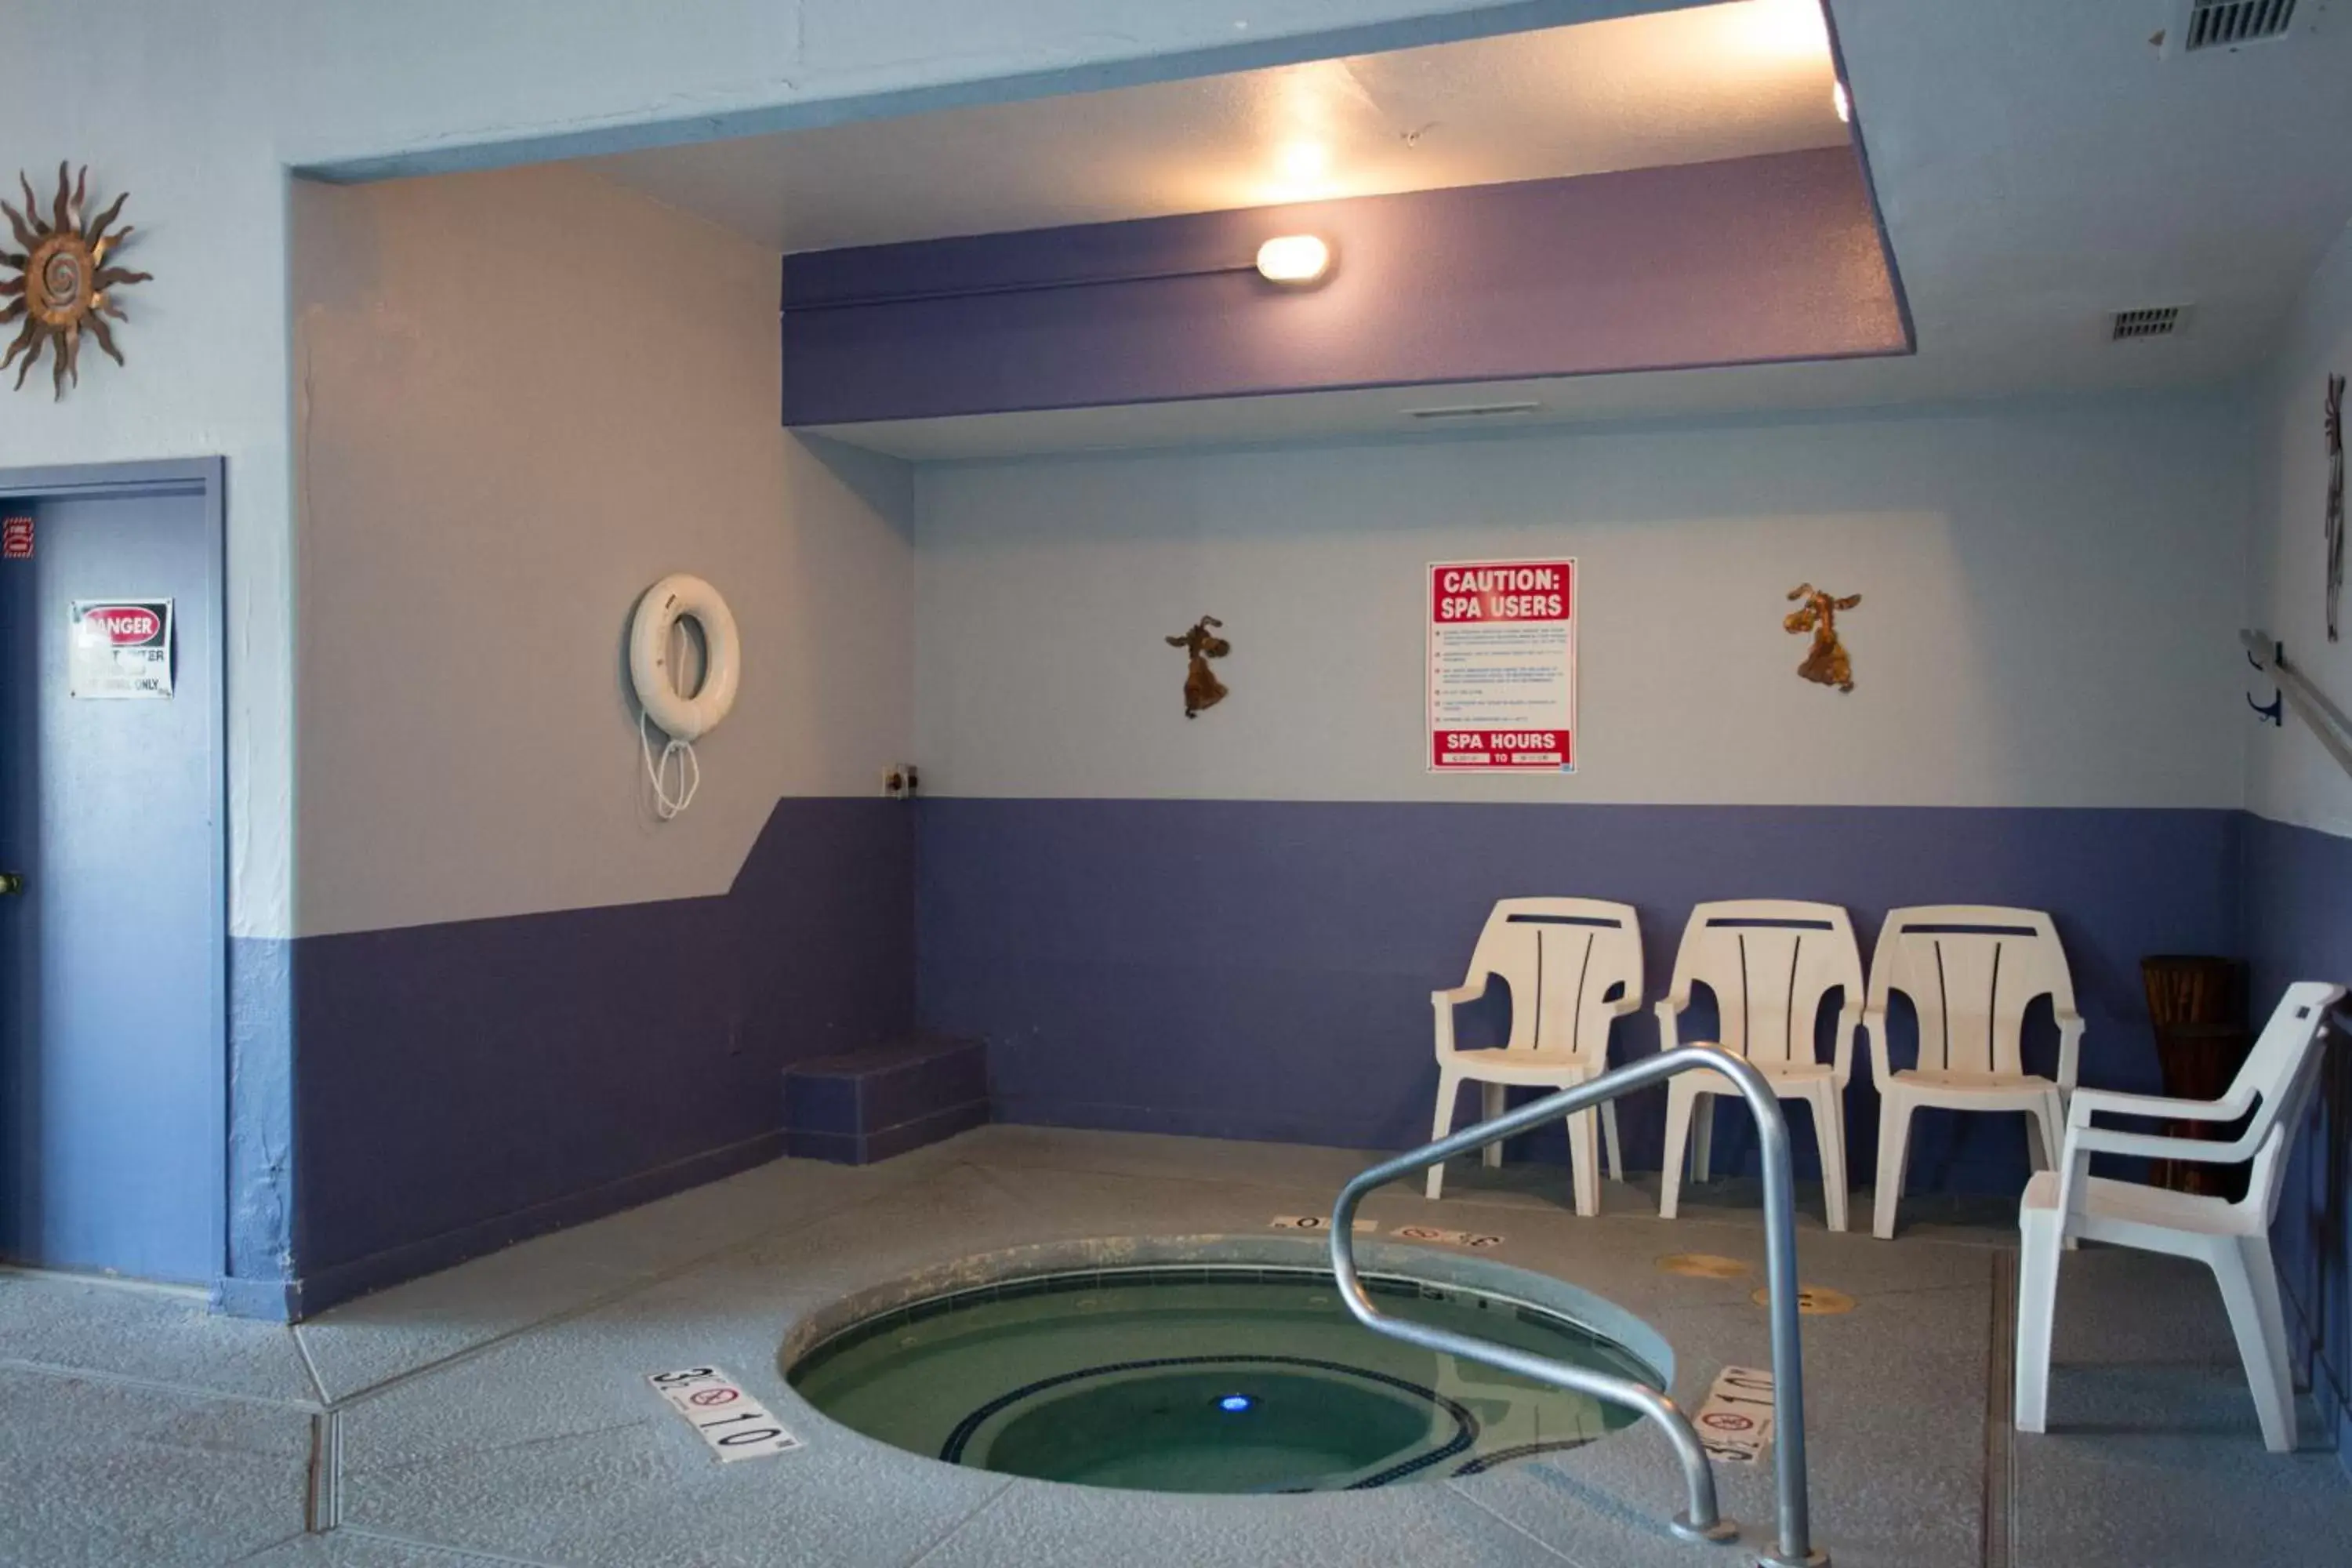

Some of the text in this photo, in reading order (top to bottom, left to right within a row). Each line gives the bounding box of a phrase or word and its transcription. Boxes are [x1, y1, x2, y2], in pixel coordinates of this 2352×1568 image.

[1443, 569, 1559, 593] CAUTION:
[1441, 594, 1562, 619] SPA USERS
[87, 616, 154, 634] ANGER
[1447, 733, 1555, 750] SPA HOURS
[1494, 753, 1508, 764] TO
[700, 1413, 782, 1446] 10
